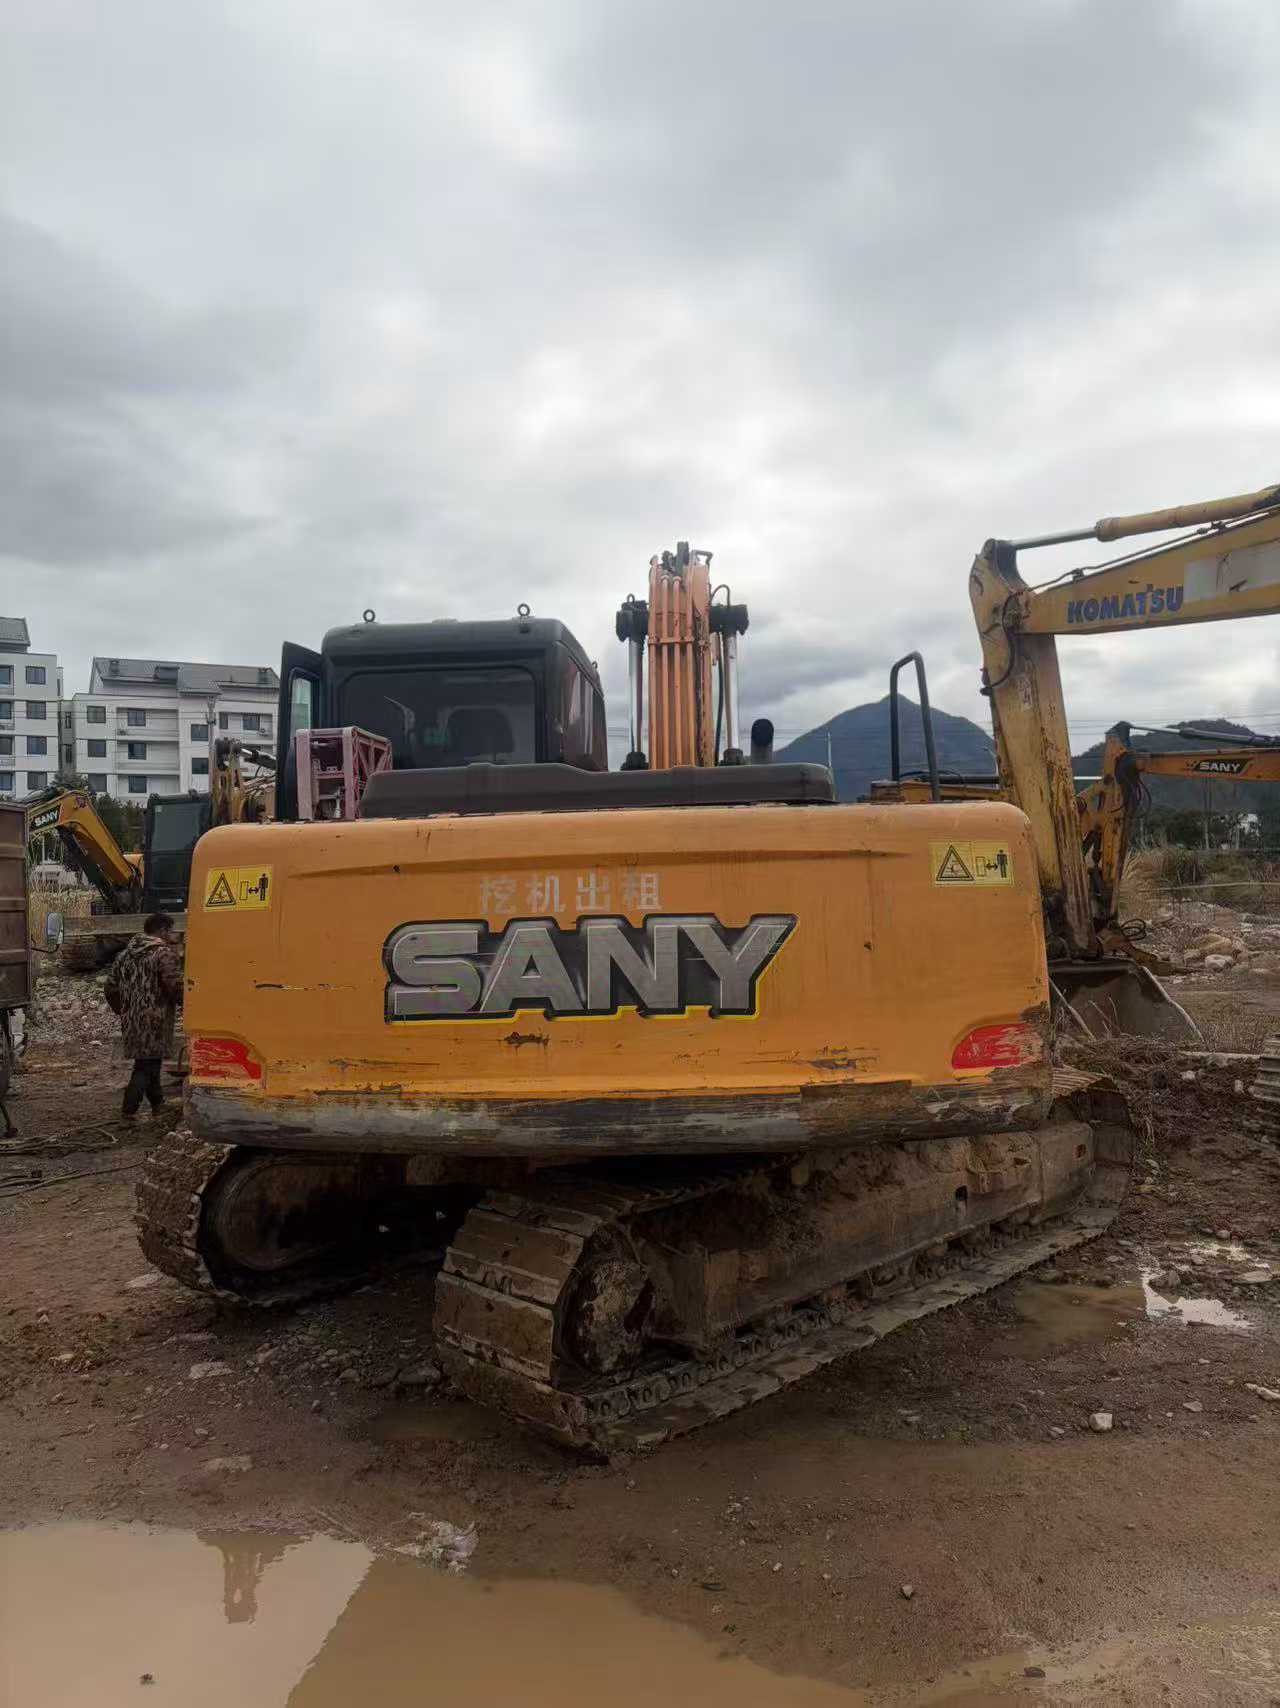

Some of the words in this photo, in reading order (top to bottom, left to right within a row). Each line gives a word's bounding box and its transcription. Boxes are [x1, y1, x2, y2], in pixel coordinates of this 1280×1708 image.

[1066, 585, 1184, 624] KOMATSU
[1199, 761, 1240, 773] SANY
[479, 871, 662, 915] 挖机出租
[386, 915, 796, 1017] SANY
